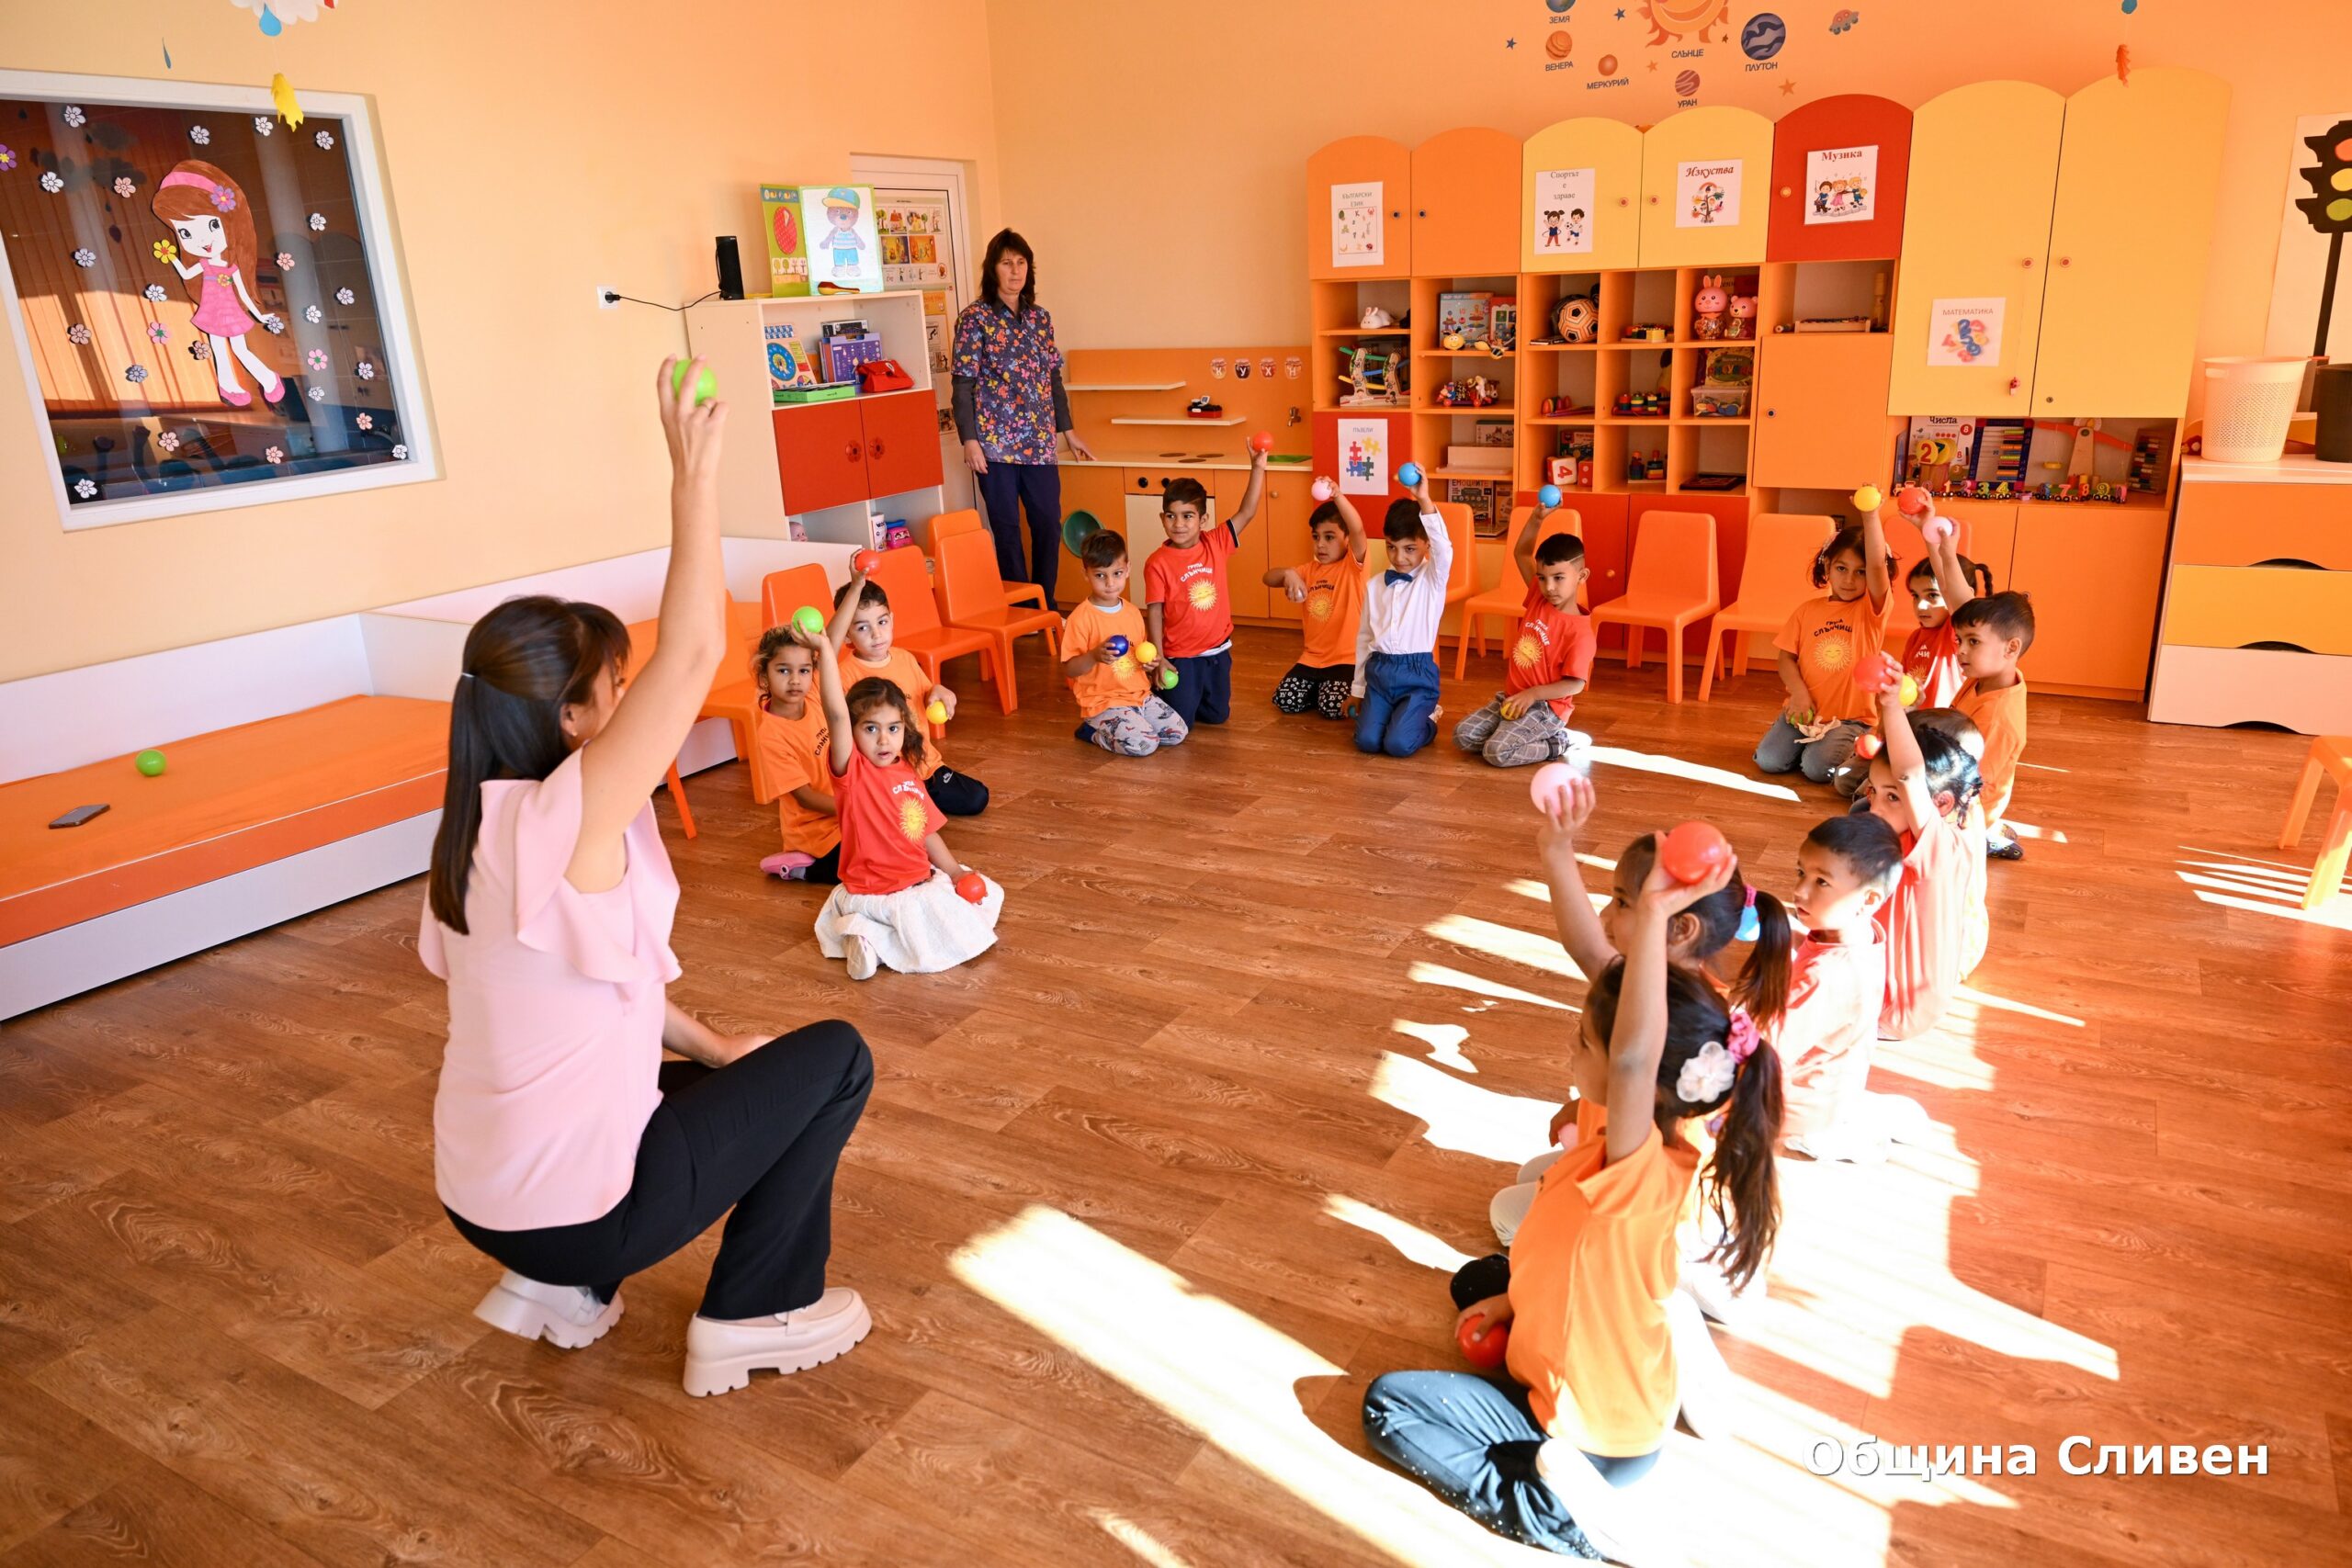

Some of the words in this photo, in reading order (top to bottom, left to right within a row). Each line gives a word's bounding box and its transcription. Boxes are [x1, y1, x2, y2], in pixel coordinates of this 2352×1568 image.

[1549, 16, 1570, 24] ЗЕМЯ
[1671, 49, 1704, 58] СЛЪНЦЕ
[1545, 61, 1573, 71] ВЕНЕРА
[1745, 62, 1778, 72] ПЛУТОН
[1587, 77, 1629, 89] МЕРКУРИЙ
[1678, 98, 1698, 108] УРАН
[1822, 151, 1862, 162] Музика
[1550, 171, 1579, 179] Спортът
[1920, 443, 1932, 463] 2
[1814, 624, 1853, 637] СЛЪНЧИЦ
